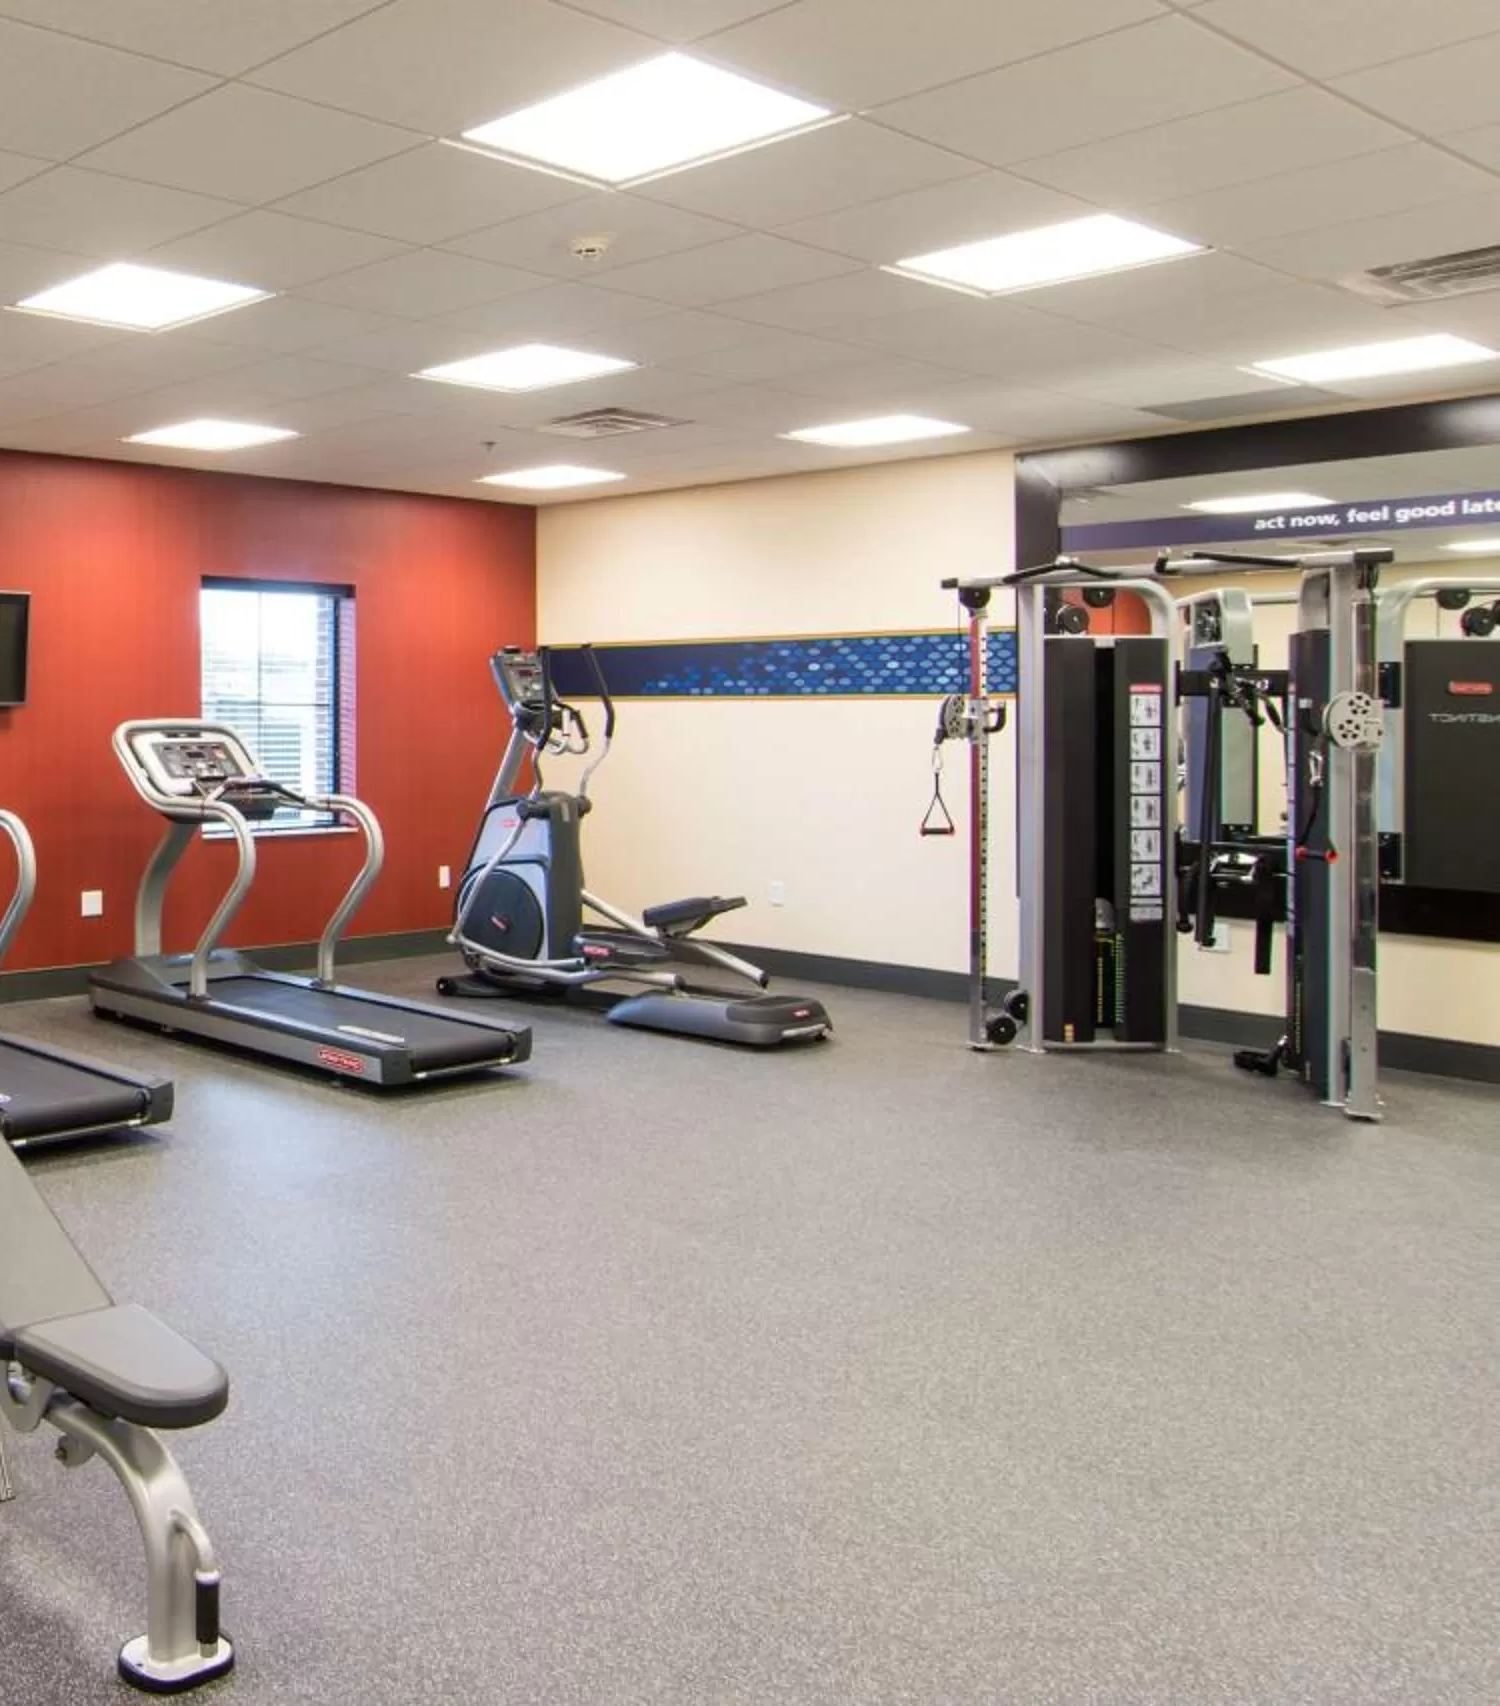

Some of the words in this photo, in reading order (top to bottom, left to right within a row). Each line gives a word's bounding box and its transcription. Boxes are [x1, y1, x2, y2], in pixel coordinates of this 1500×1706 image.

[1254, 516, 1285, 531] act
[1290, 513, 1341, 527] now,
[1346, 506, 1389, 523] feel
[1394, 500, 1455, 522] good
